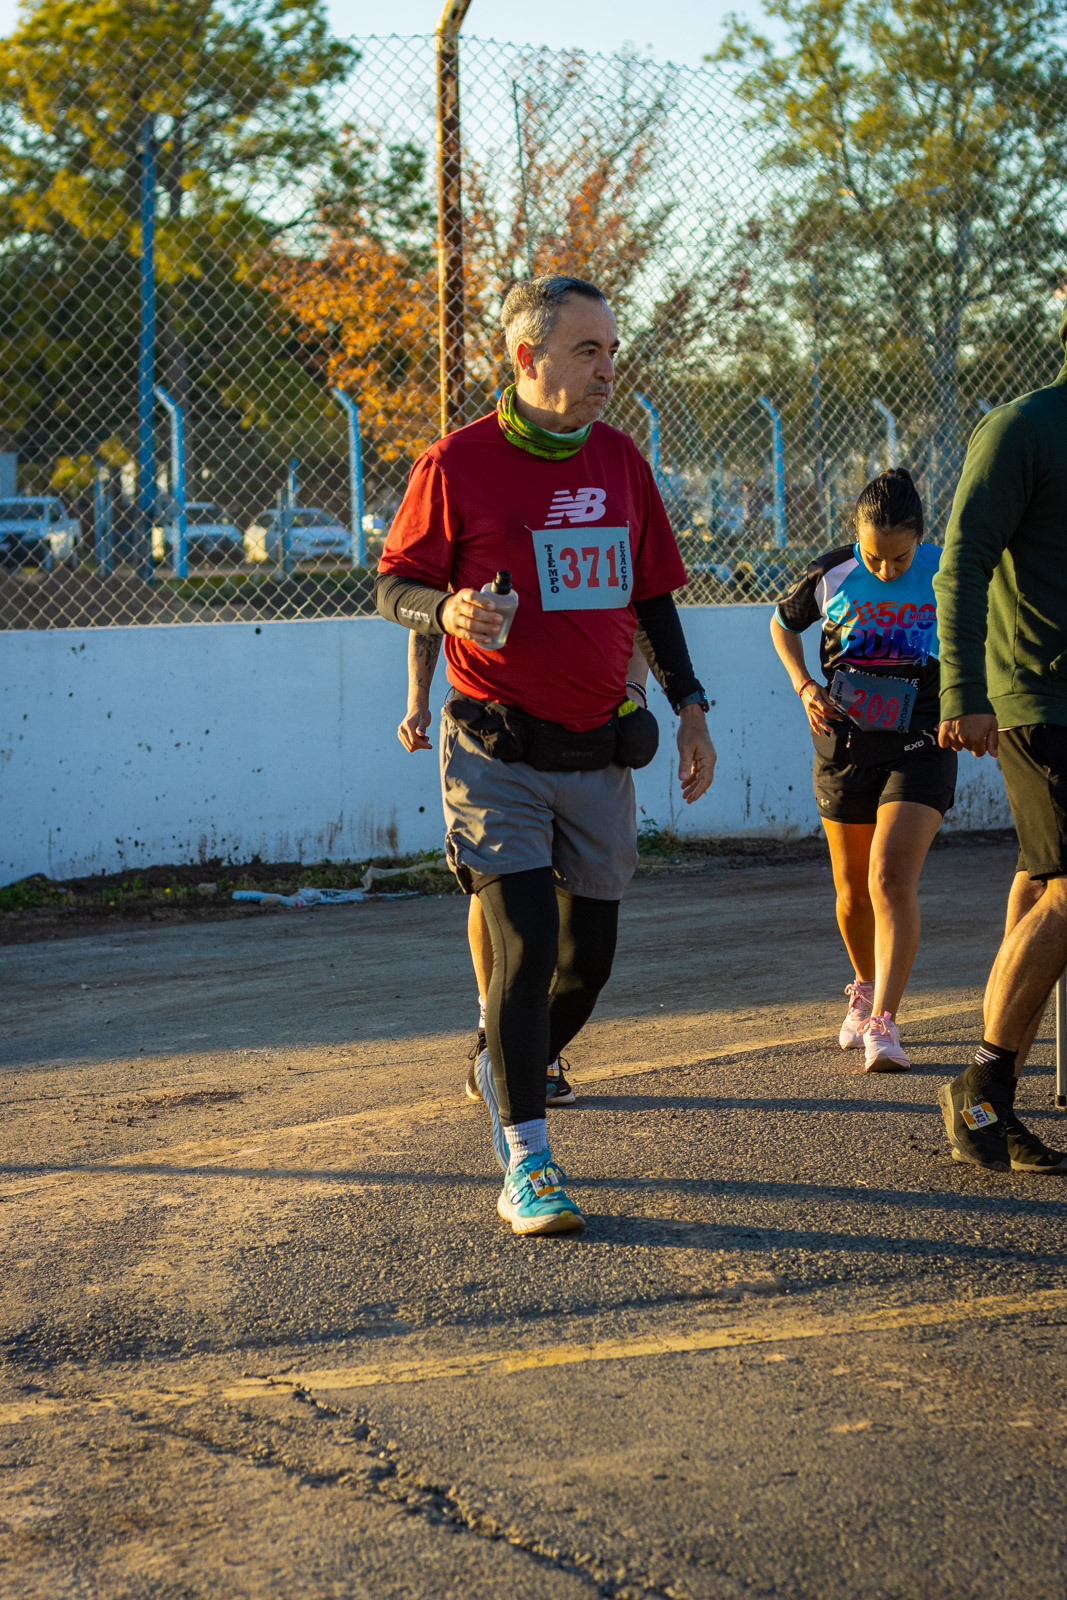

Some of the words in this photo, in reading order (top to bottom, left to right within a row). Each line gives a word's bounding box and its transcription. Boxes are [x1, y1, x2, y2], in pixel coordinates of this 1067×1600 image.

[544, 487, 607, 526] NB
[544, 544, 560, 594] TIEMPO
[559, 544, 620, 589] 371
[619, 541, 629, 591] EXACTO
[838, 626, 920, 658] RUN
[847, 688, 900, 727] 209
